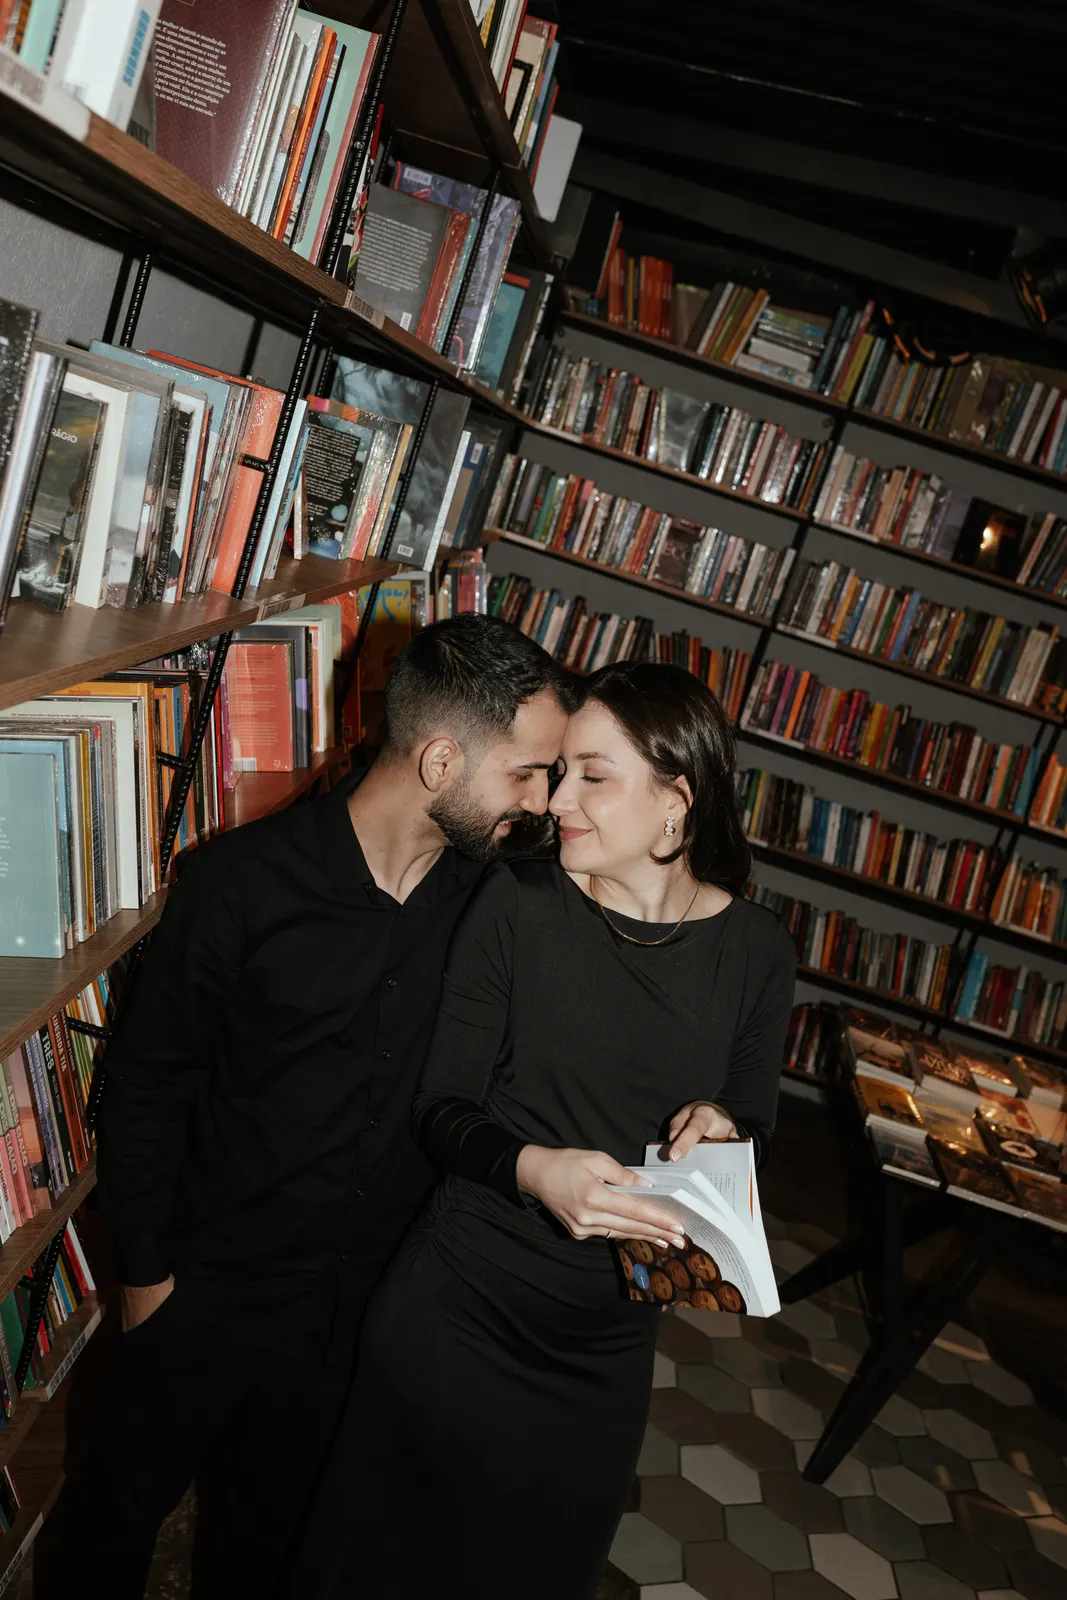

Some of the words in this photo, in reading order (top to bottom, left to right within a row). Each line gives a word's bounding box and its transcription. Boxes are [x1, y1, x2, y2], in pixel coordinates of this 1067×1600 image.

[161, 19, 179, 30] mulher
[59, 1054, 67, 1071] TIA
[30, 1072, 36, 1081] DE
[37, 1067, 42, 1076] DE
[32, 1082, 43, 1114] DOMINGO
[39, 1077, 49, 1108] DOMINGO
